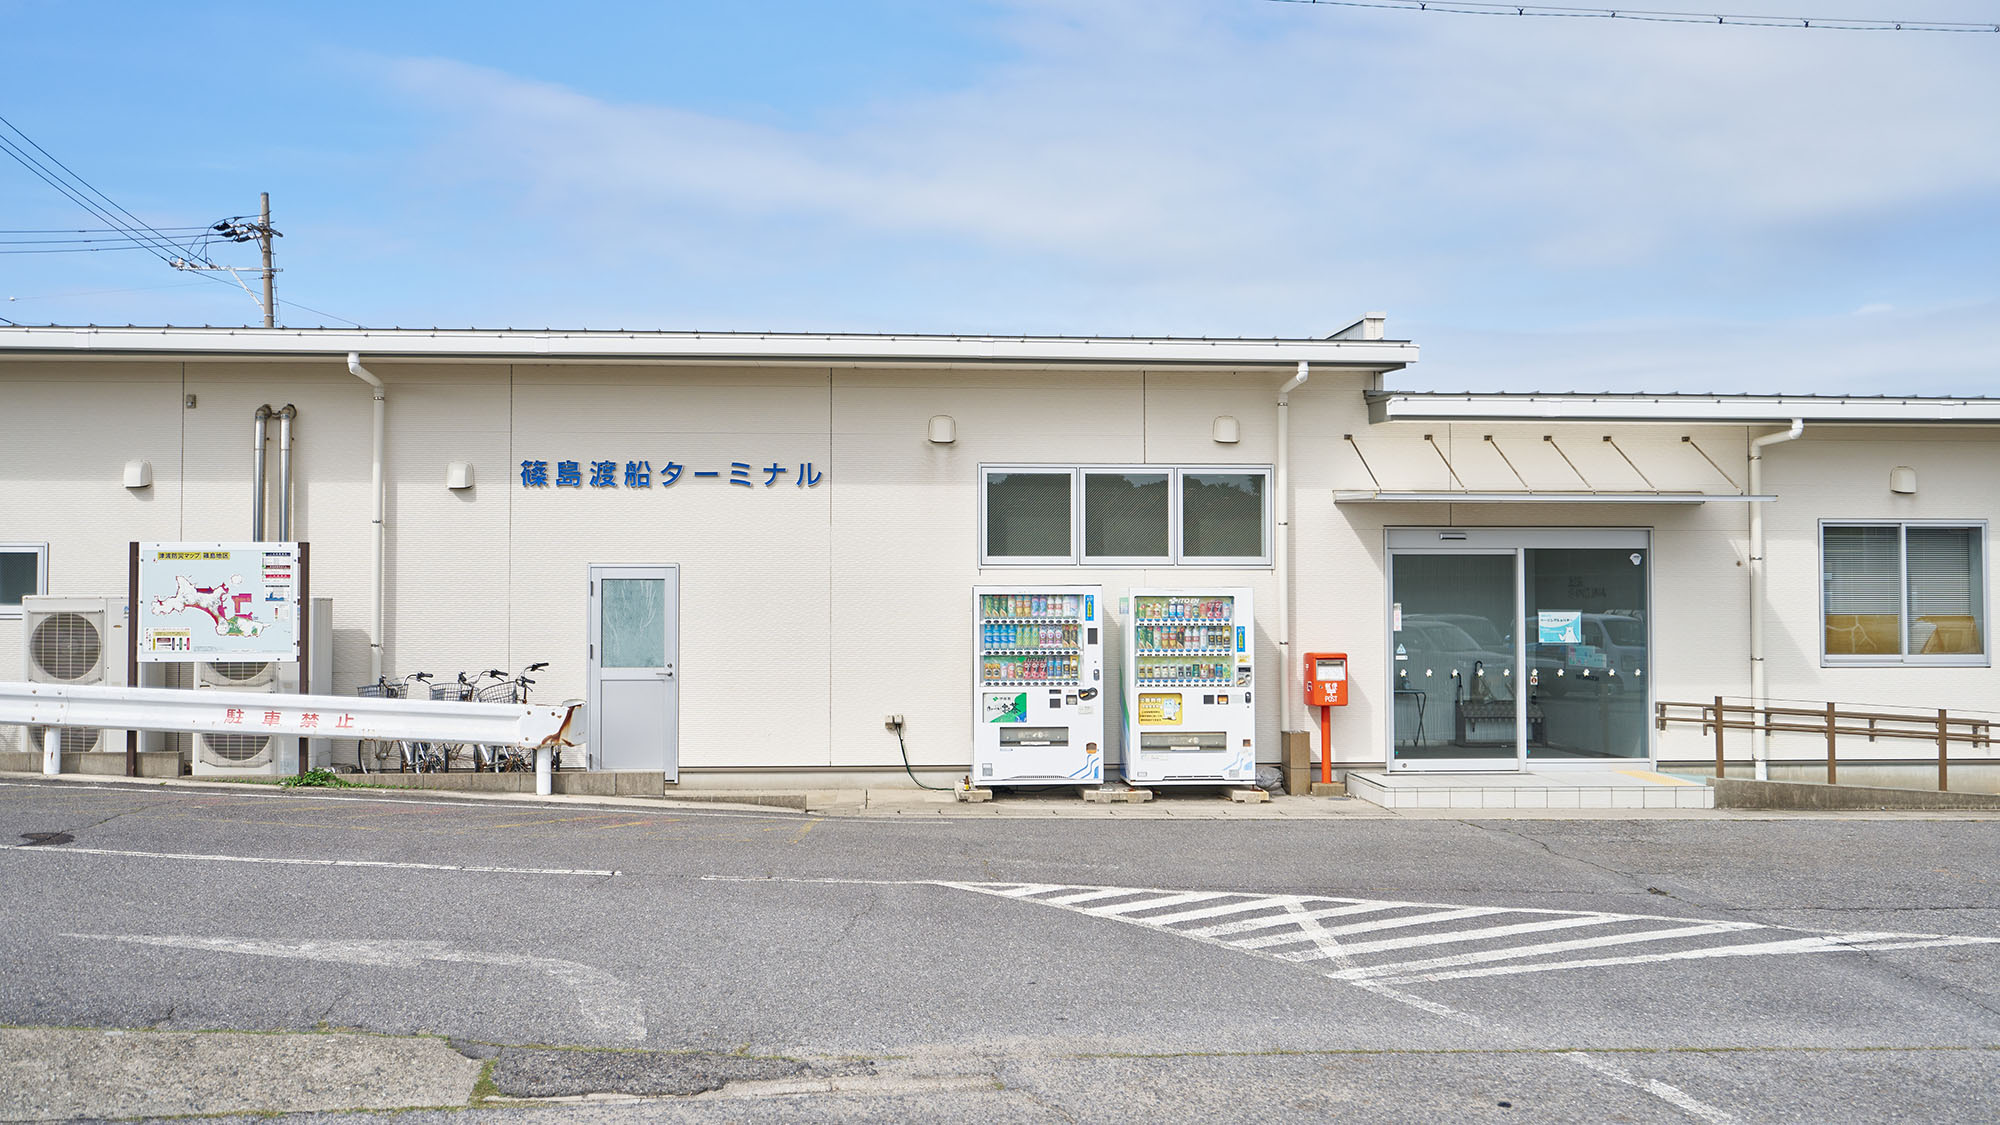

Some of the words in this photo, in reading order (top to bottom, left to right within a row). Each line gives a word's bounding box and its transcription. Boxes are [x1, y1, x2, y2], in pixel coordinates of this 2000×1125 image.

[520, 459, 823, 488] 篠島渡船ターミナル
[224, 708, 355, 729] 駐車禁止
